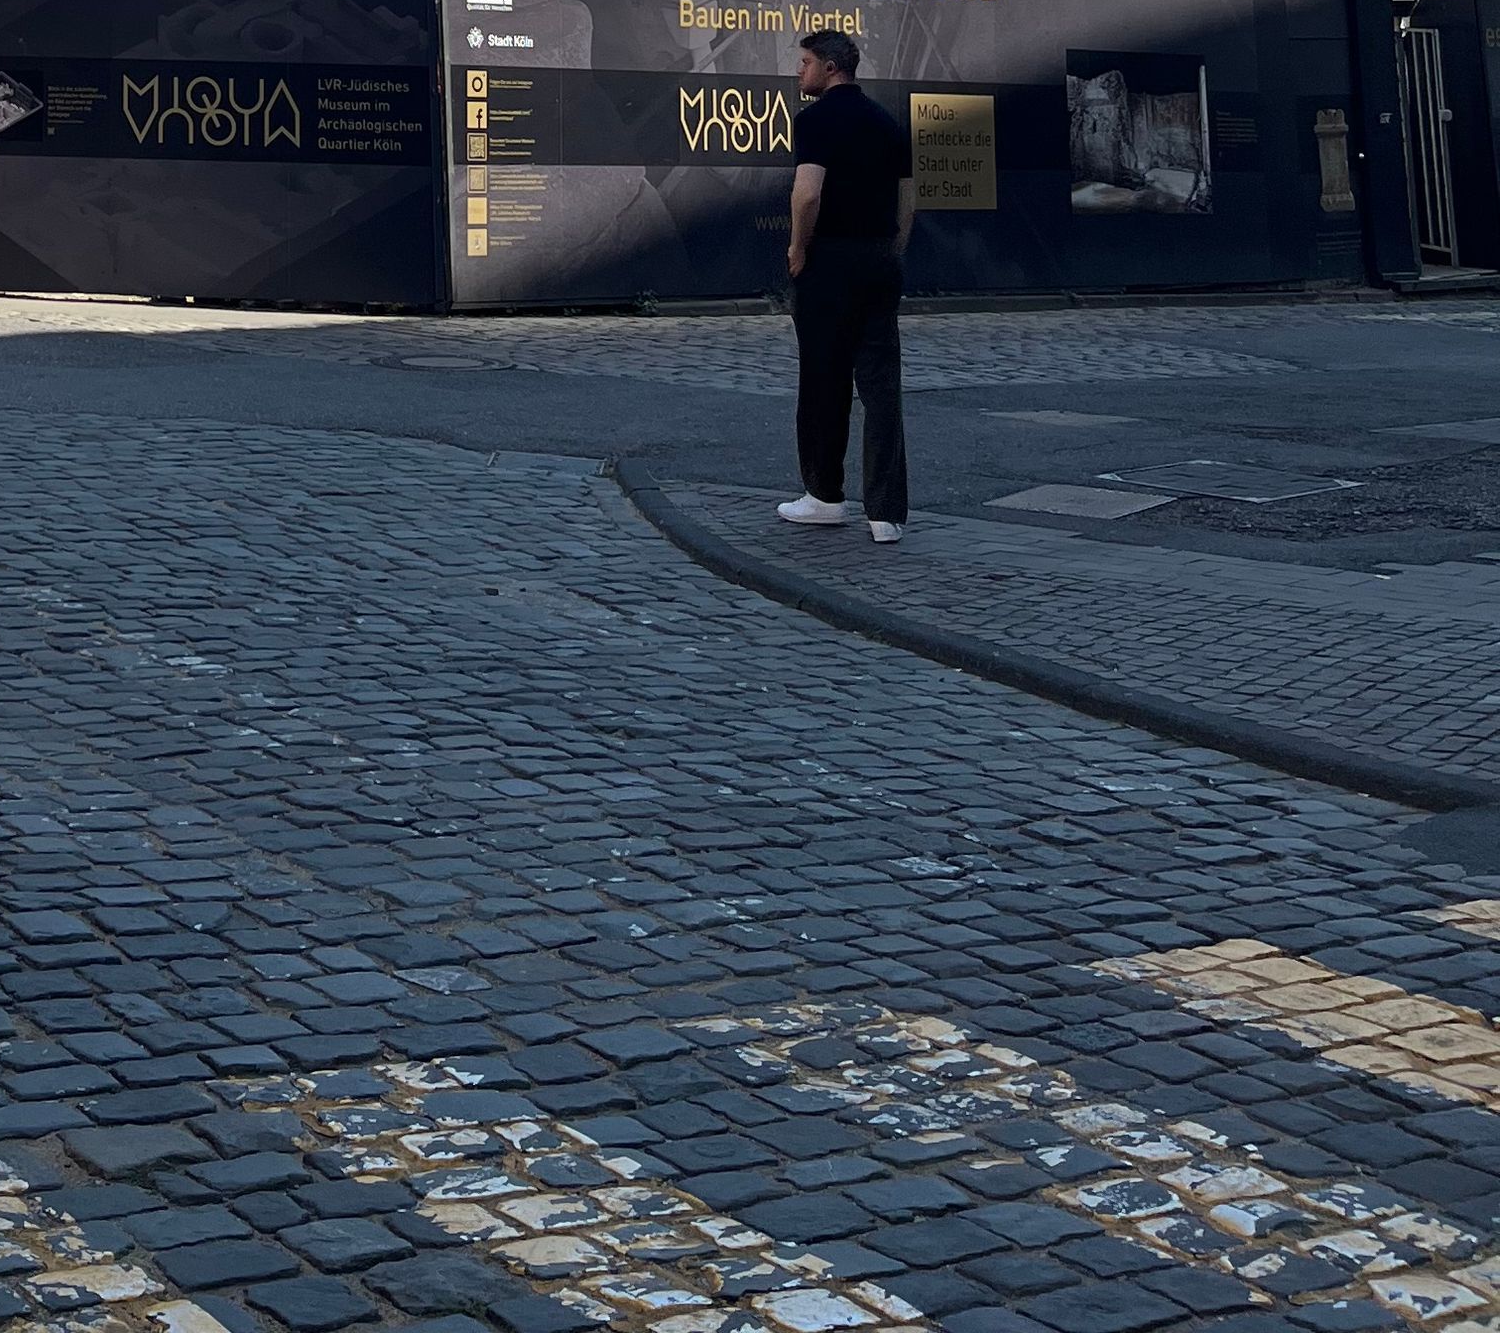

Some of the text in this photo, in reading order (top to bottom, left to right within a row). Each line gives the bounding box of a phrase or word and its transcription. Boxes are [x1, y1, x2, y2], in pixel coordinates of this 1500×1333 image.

[757, 2, 784, 32] im
[789, 4, 863, 36] Viertel
[488, 34, 534, 48] Stadt Köln
[317, 78, 410, 93] LVR-Jüdisches
[317, 97, 391, 112] Museum im
[918, 103, 959, 121] MiQua:
[317, 117, 423, 134] Archäologischen
[318, 137, 402, 152] Quartier Köln
[918, 130, 992, 148] Entdecke die
[918, 154, 984, 173] Stadt unter
[919, 180, 973, 199] der Stadt
